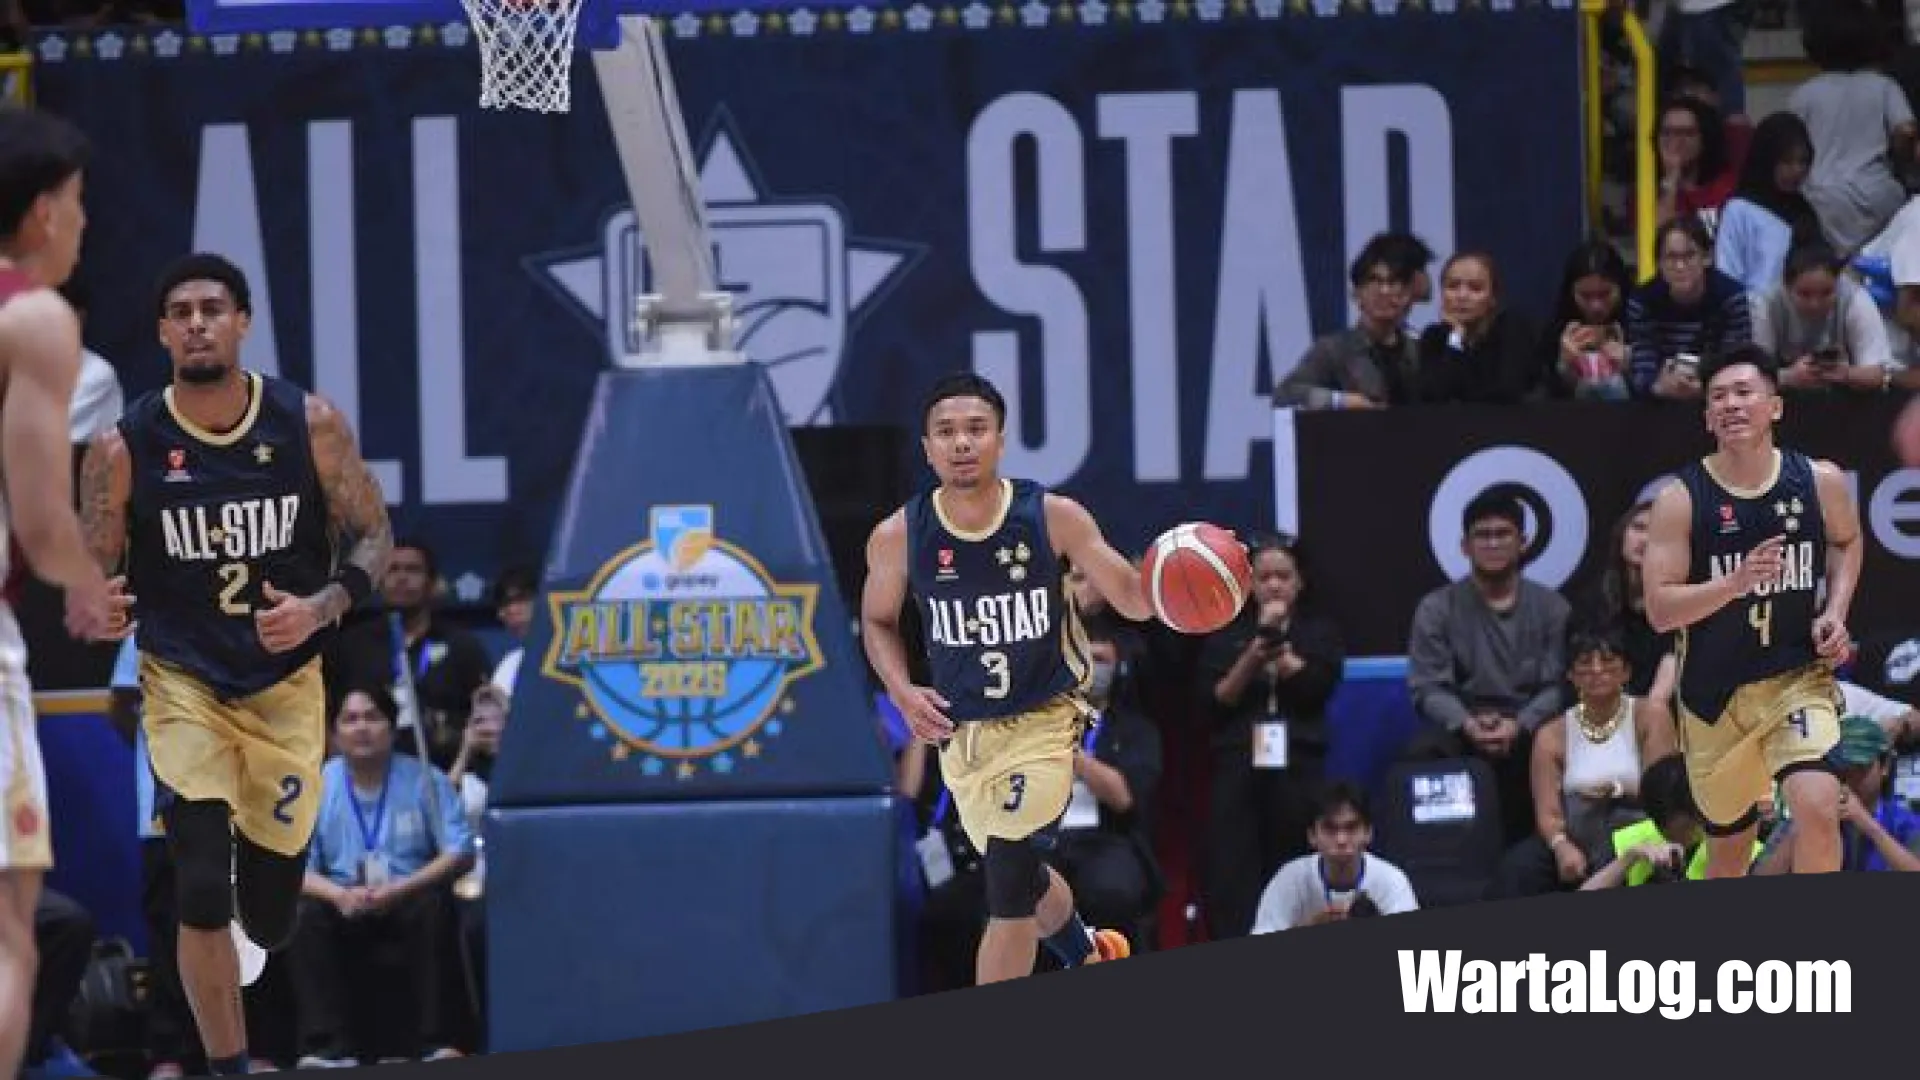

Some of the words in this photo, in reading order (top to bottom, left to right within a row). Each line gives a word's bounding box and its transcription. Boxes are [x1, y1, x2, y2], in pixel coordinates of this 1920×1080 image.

[216, 561, 251, 615] 2
[1748, 600, 1773, 648] 4
[979, 651, 1012, 699] 3
[1786, 706, 1809, 739] 4
[273, 774, 304, 825] 2
[1002, 772, 1027, 812] 3
